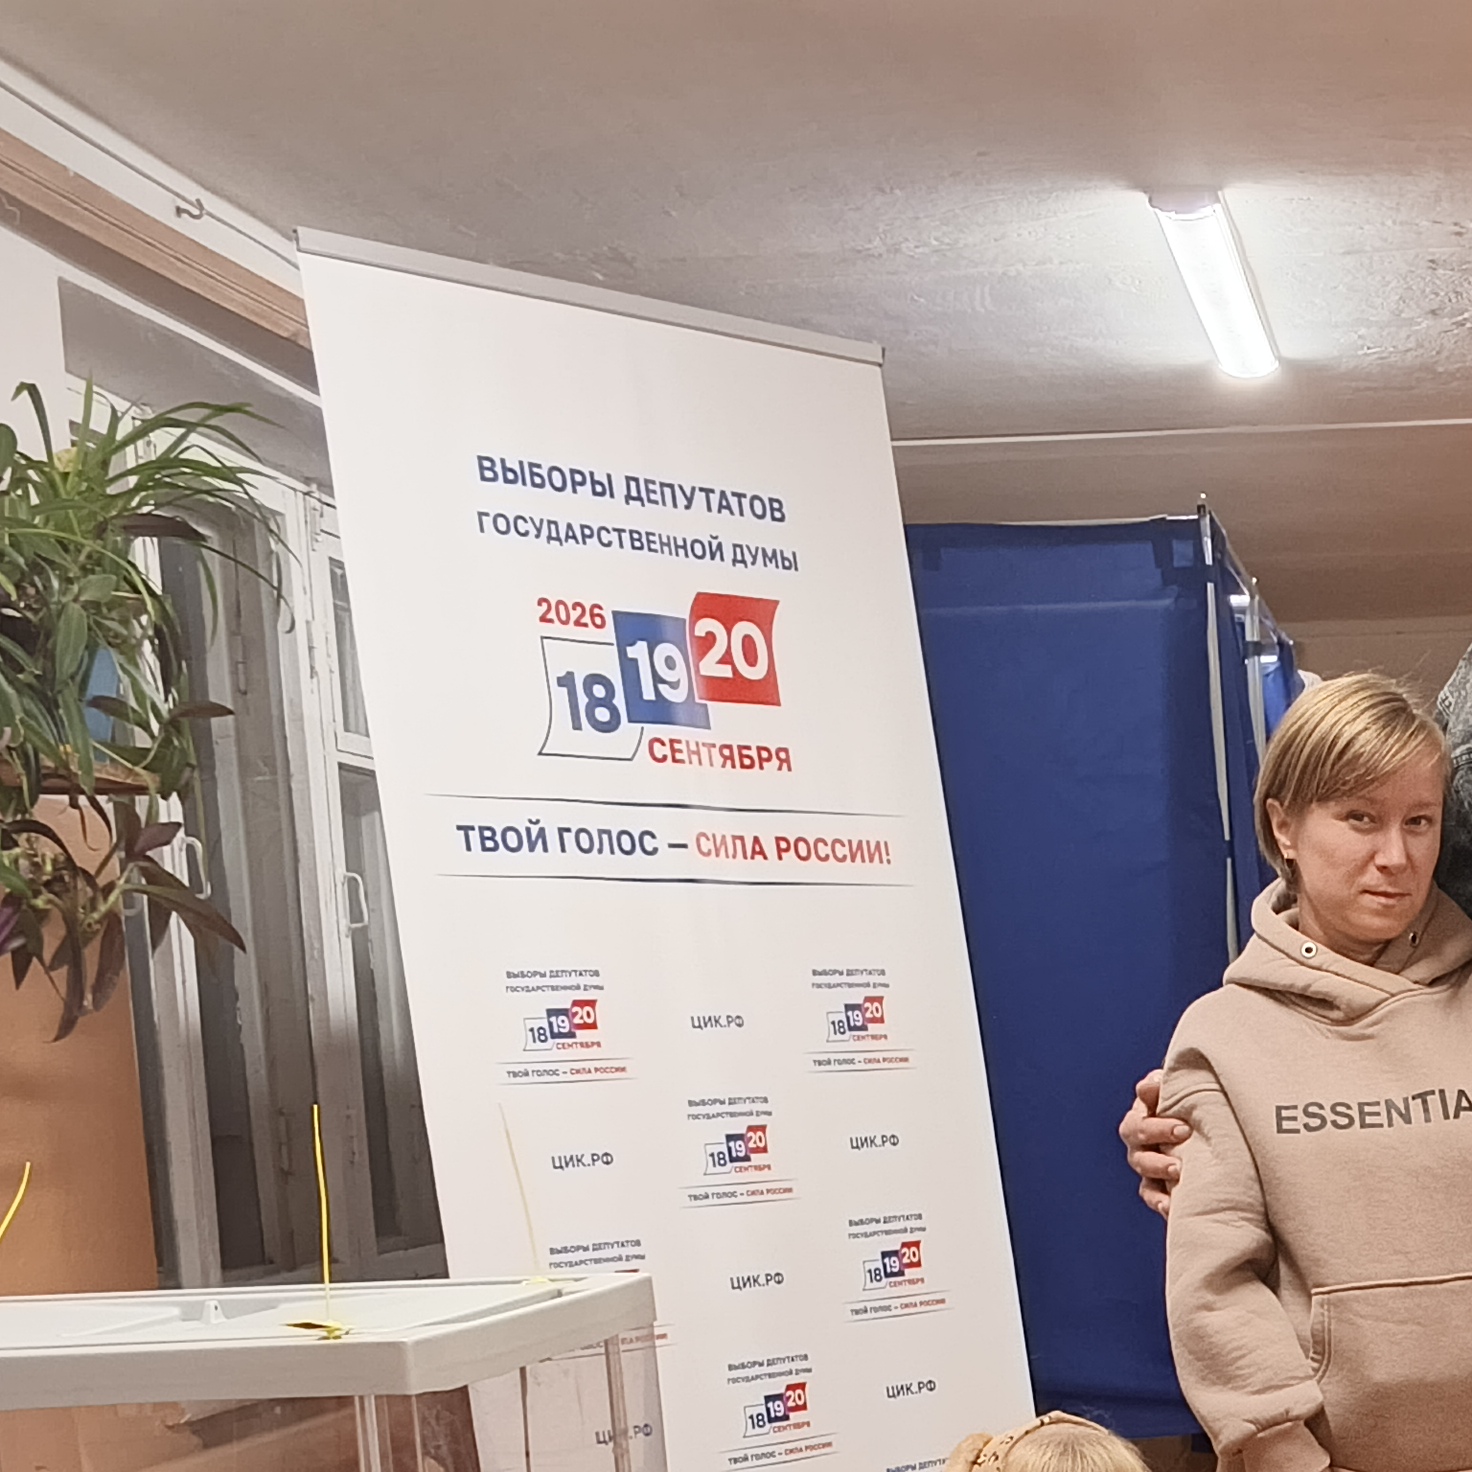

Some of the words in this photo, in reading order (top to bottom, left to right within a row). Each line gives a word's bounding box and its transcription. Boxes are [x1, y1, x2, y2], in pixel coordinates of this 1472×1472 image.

[476, 455, 614, 499] ВЫБОРЫ
[624, 475, 786, 523] ДЕПУТАТОВ
[476, 511, 724, 563] ГОСУДАРСТВЕННОЙ
[731, 543, 799, 572] ДУМЫ
[537, 597, 607, 629] 2026
[556, 670, 622, 734] 18
[626, 639, 689, 703] 19
[694, 617, 770, 681] 20
[648, 736, 793, 773] СЕНТЯБРЯ
[456, 819, 549, 854] ТВОЙ
[557, 827, 659, 856] ГОЛОС
[696, 831, 768, 861] СИЛА
[776, 835, 892, 865] РОССИИ!
[528, 1026, 548, 1043] 18
[550, 1016, 570, 1033] 19
[572, 1006, 594, 1023] 20
[691, 1014, 744, 1030] ЦИК.РФ
[831, 1020, 846, 1036] 18
[848, 1010, 863, 1027] 19
[864, 1002, 882, 1018] 20
[709, 1151, 727, 1168] 18
[729, 1140, 746, 1157] 19
[747, 1131, 765, 1147] 20
[850, 1134, 900, 1151] ЦИК.РФ
[551, 1152, 614, 1171] ЦИК.РФ
[730, 1272, 785, 1291] ЦИК.РФ
[867, 1267, 883, 1283] 18
[884, 1256, 898, 1273] 19
[901, 1247, 918, 1263] 20
[886, 1379, 936, 1399] ЦИК.РФ
[748, 1412, 766, 1429] 18
[767, 1400, 784, 1418] 19
[786, 1389, 804, 1407] 20
[595, 1423, 653, 1445] ЦИ.РФ
